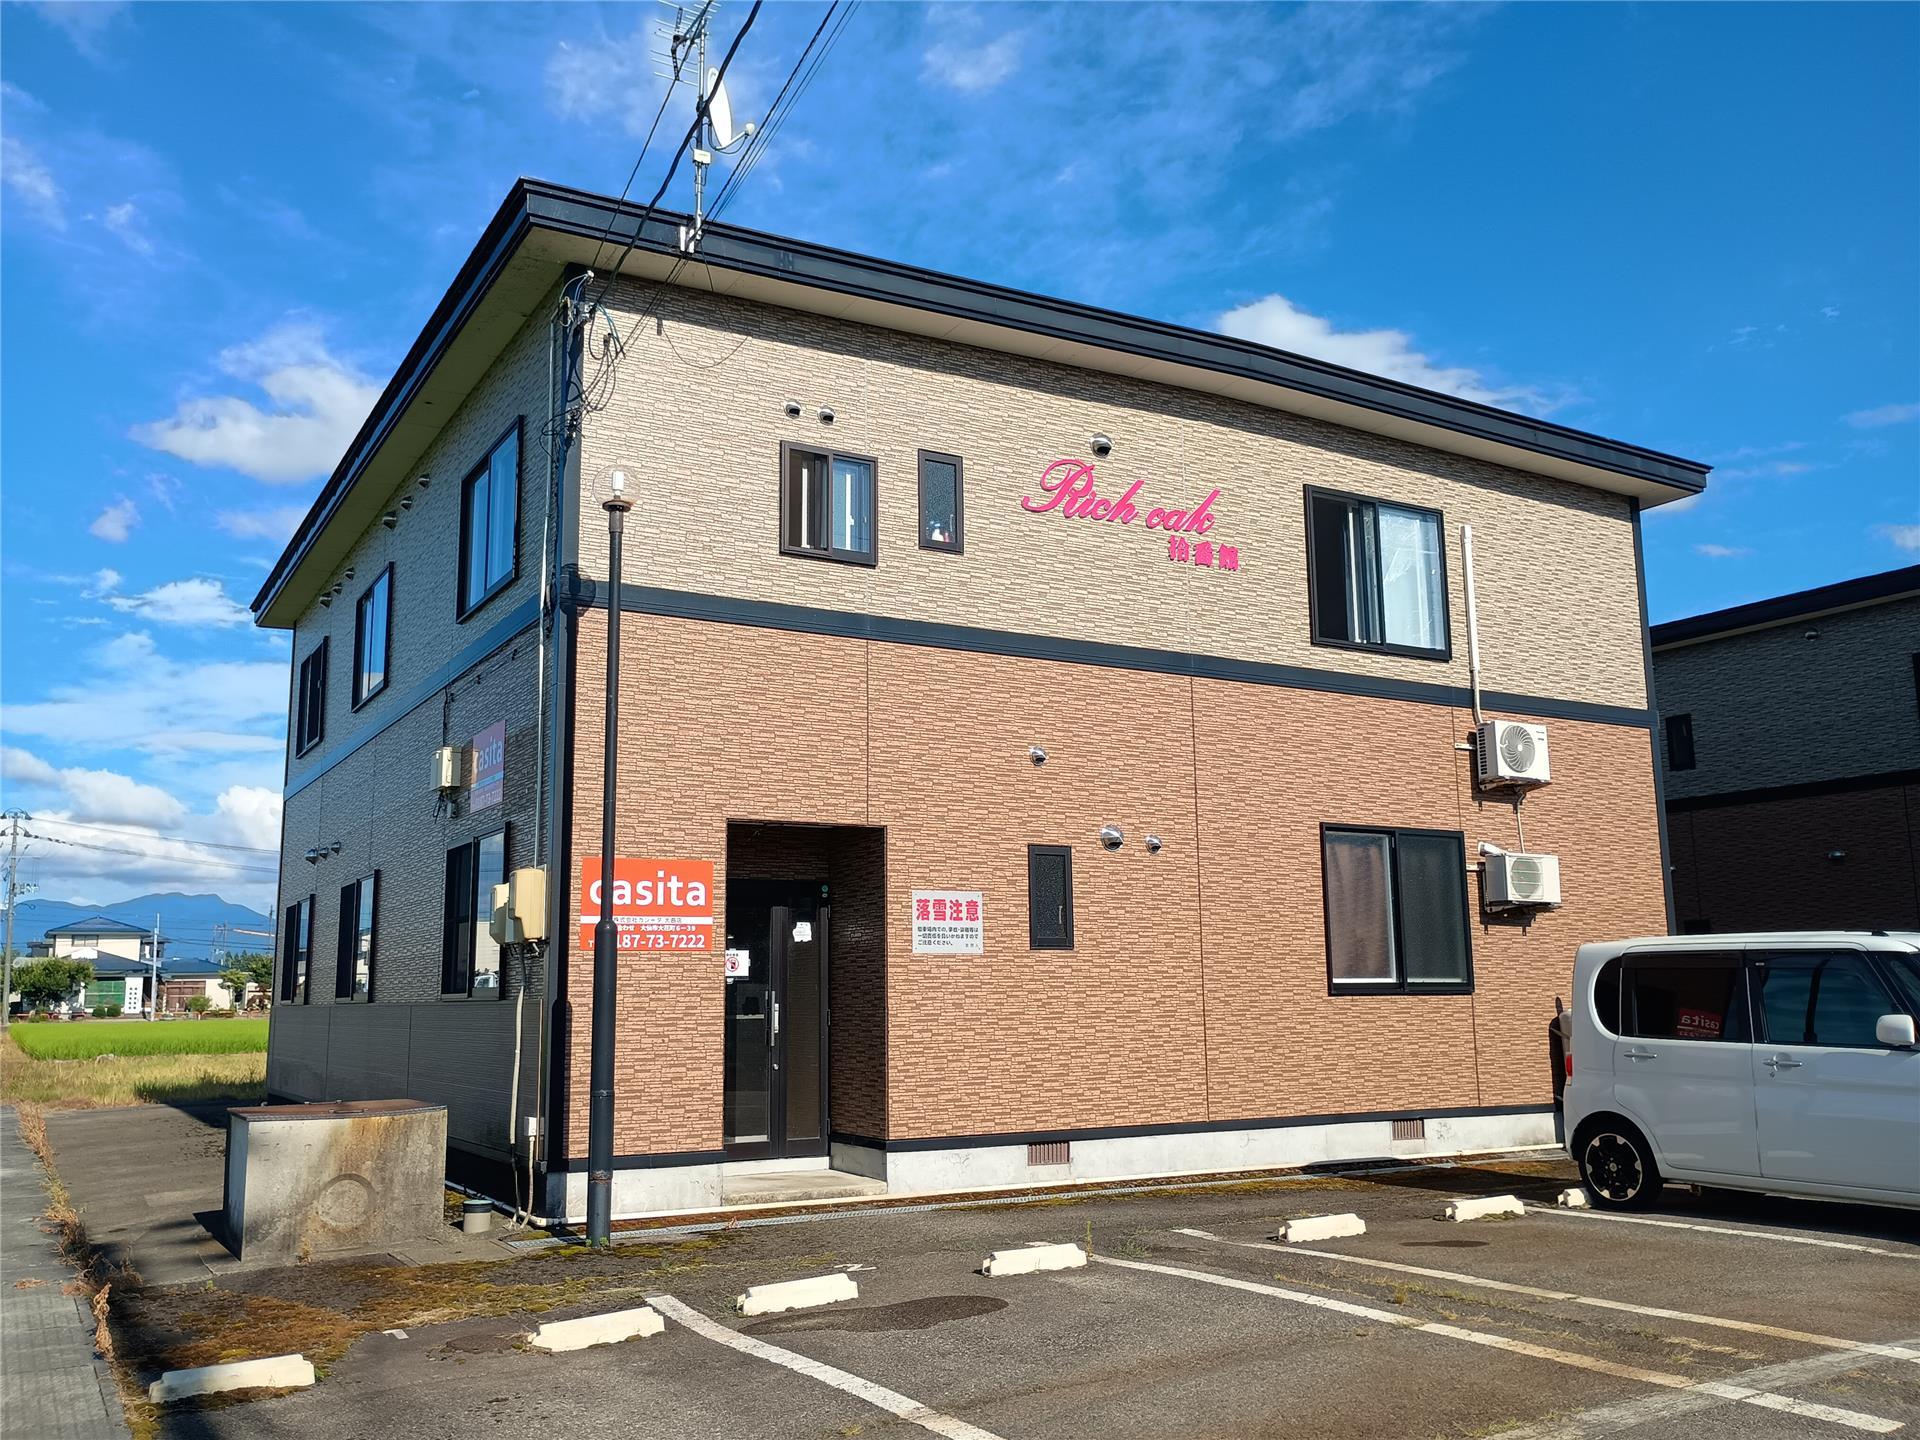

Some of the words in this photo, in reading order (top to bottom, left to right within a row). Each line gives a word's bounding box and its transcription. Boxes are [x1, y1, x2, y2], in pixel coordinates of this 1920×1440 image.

[1021, 458, 1145, 525] Rich
[1146, 487, 1221, 534] oak
[589, 871, 706, 906] casita
[916, 899, 979, 921] 落雪注意
[617, 934, 705, 948] 187-73-7222
